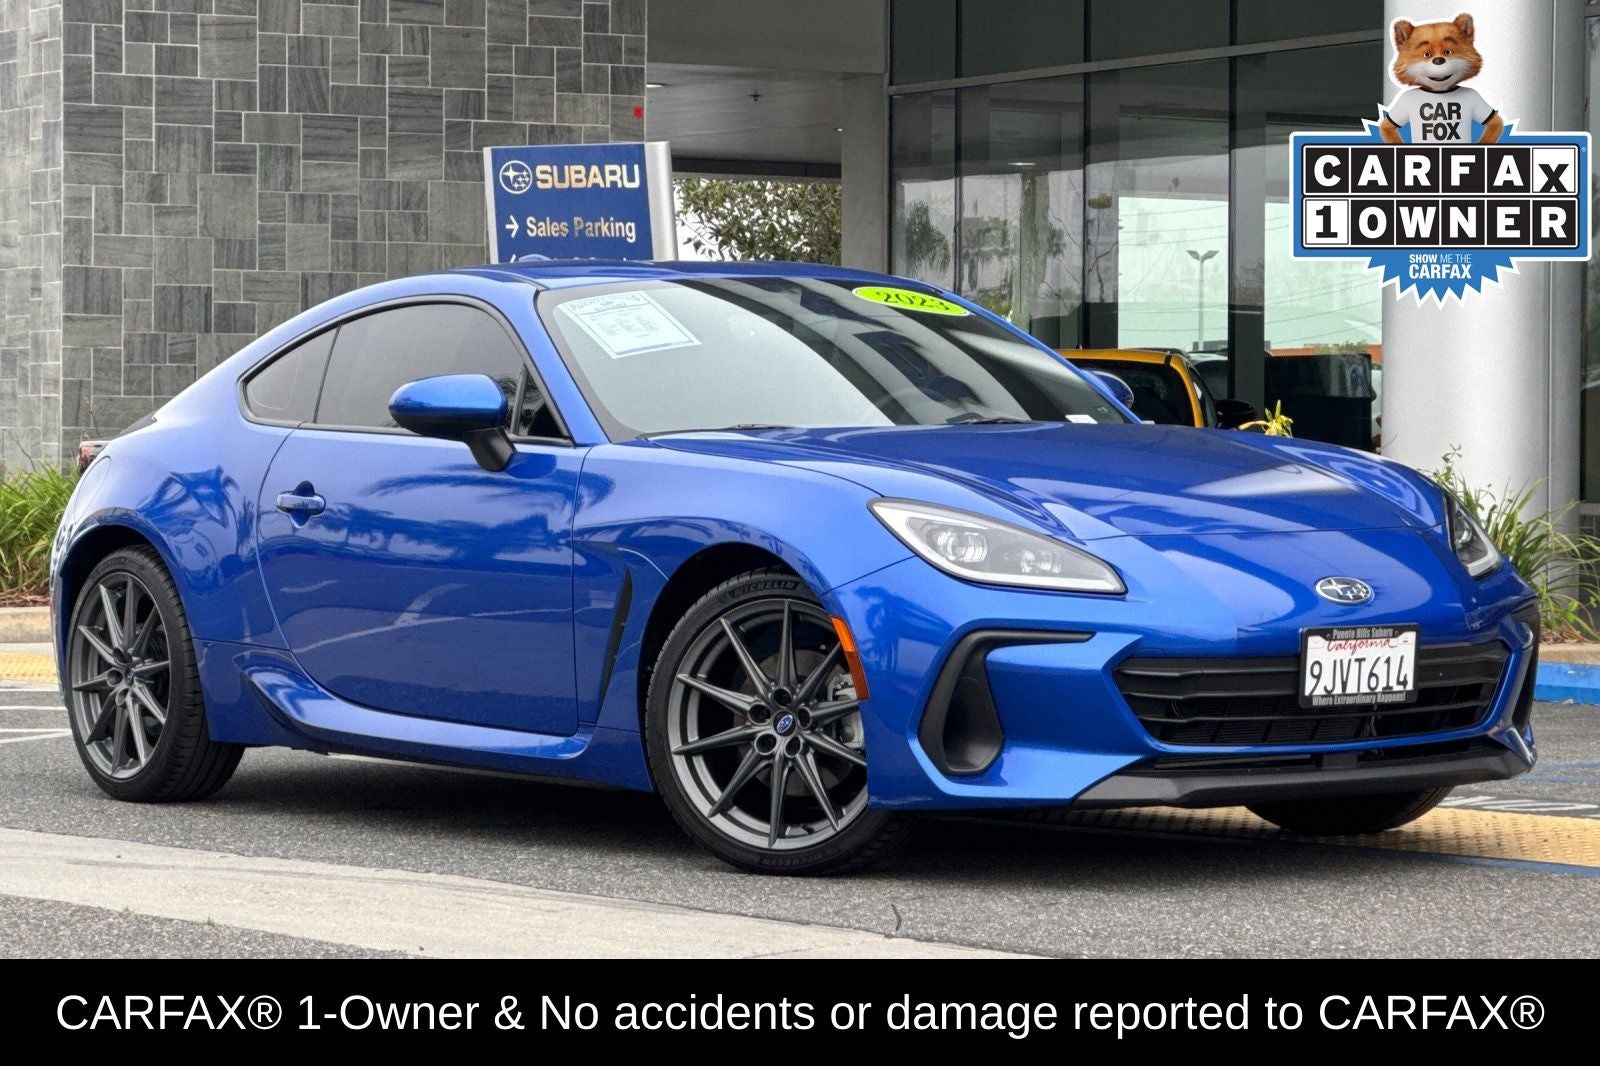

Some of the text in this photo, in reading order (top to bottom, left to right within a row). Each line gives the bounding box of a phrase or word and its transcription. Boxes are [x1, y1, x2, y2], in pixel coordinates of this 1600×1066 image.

[535, 164, 640, 189] SUBARU
[526, 216, 636, 243] Sales Parking
[876, 291, 950, 311] 2023
[734, 580, 796, 597] MICHELIN
[1309, 655, 1408, 696] 9JVT614
